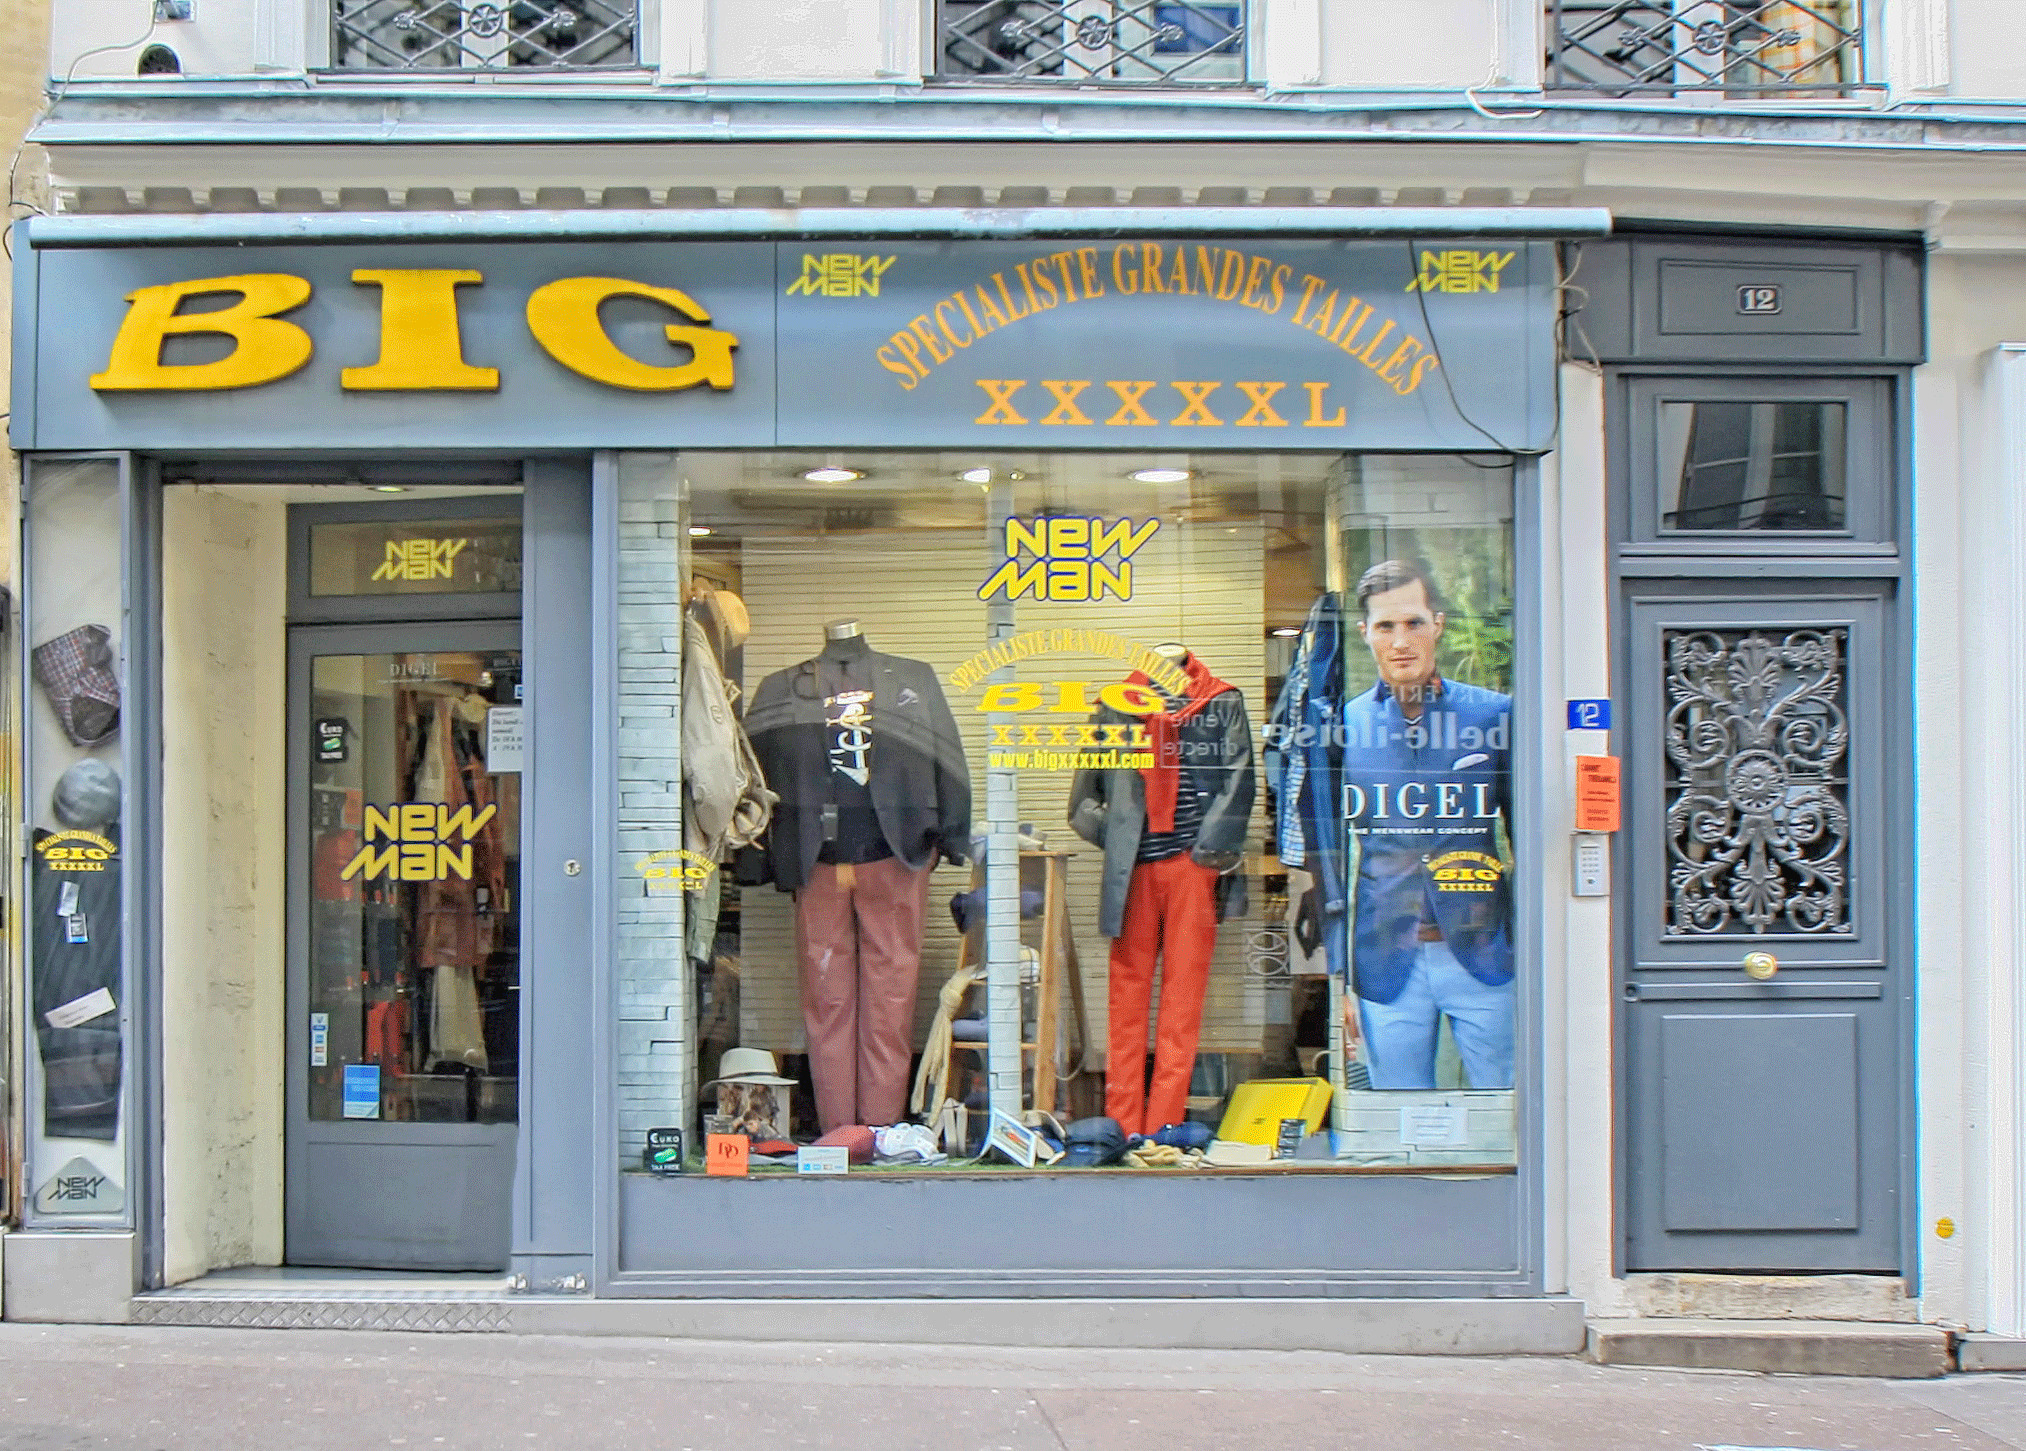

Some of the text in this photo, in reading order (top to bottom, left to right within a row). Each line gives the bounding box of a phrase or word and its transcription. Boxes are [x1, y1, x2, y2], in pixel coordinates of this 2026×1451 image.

[1744, 289, 1776, 310] 12
[89, 268, 739, 391] BIG
[876, 242, 1440, 395] SPECIALISTE GRANDES TAILLES
[949, 628, 1192, 697] SPECIALISTE GRANDES TAILLES
[975, 681, 1166, 715] BIG
[1576, 703, 1599, 727] 12
[1343, 782, 1500, 819] DIGEL
[44, 846, 109, 860] BIG
[1433, 868, 1500, 881] BIG
